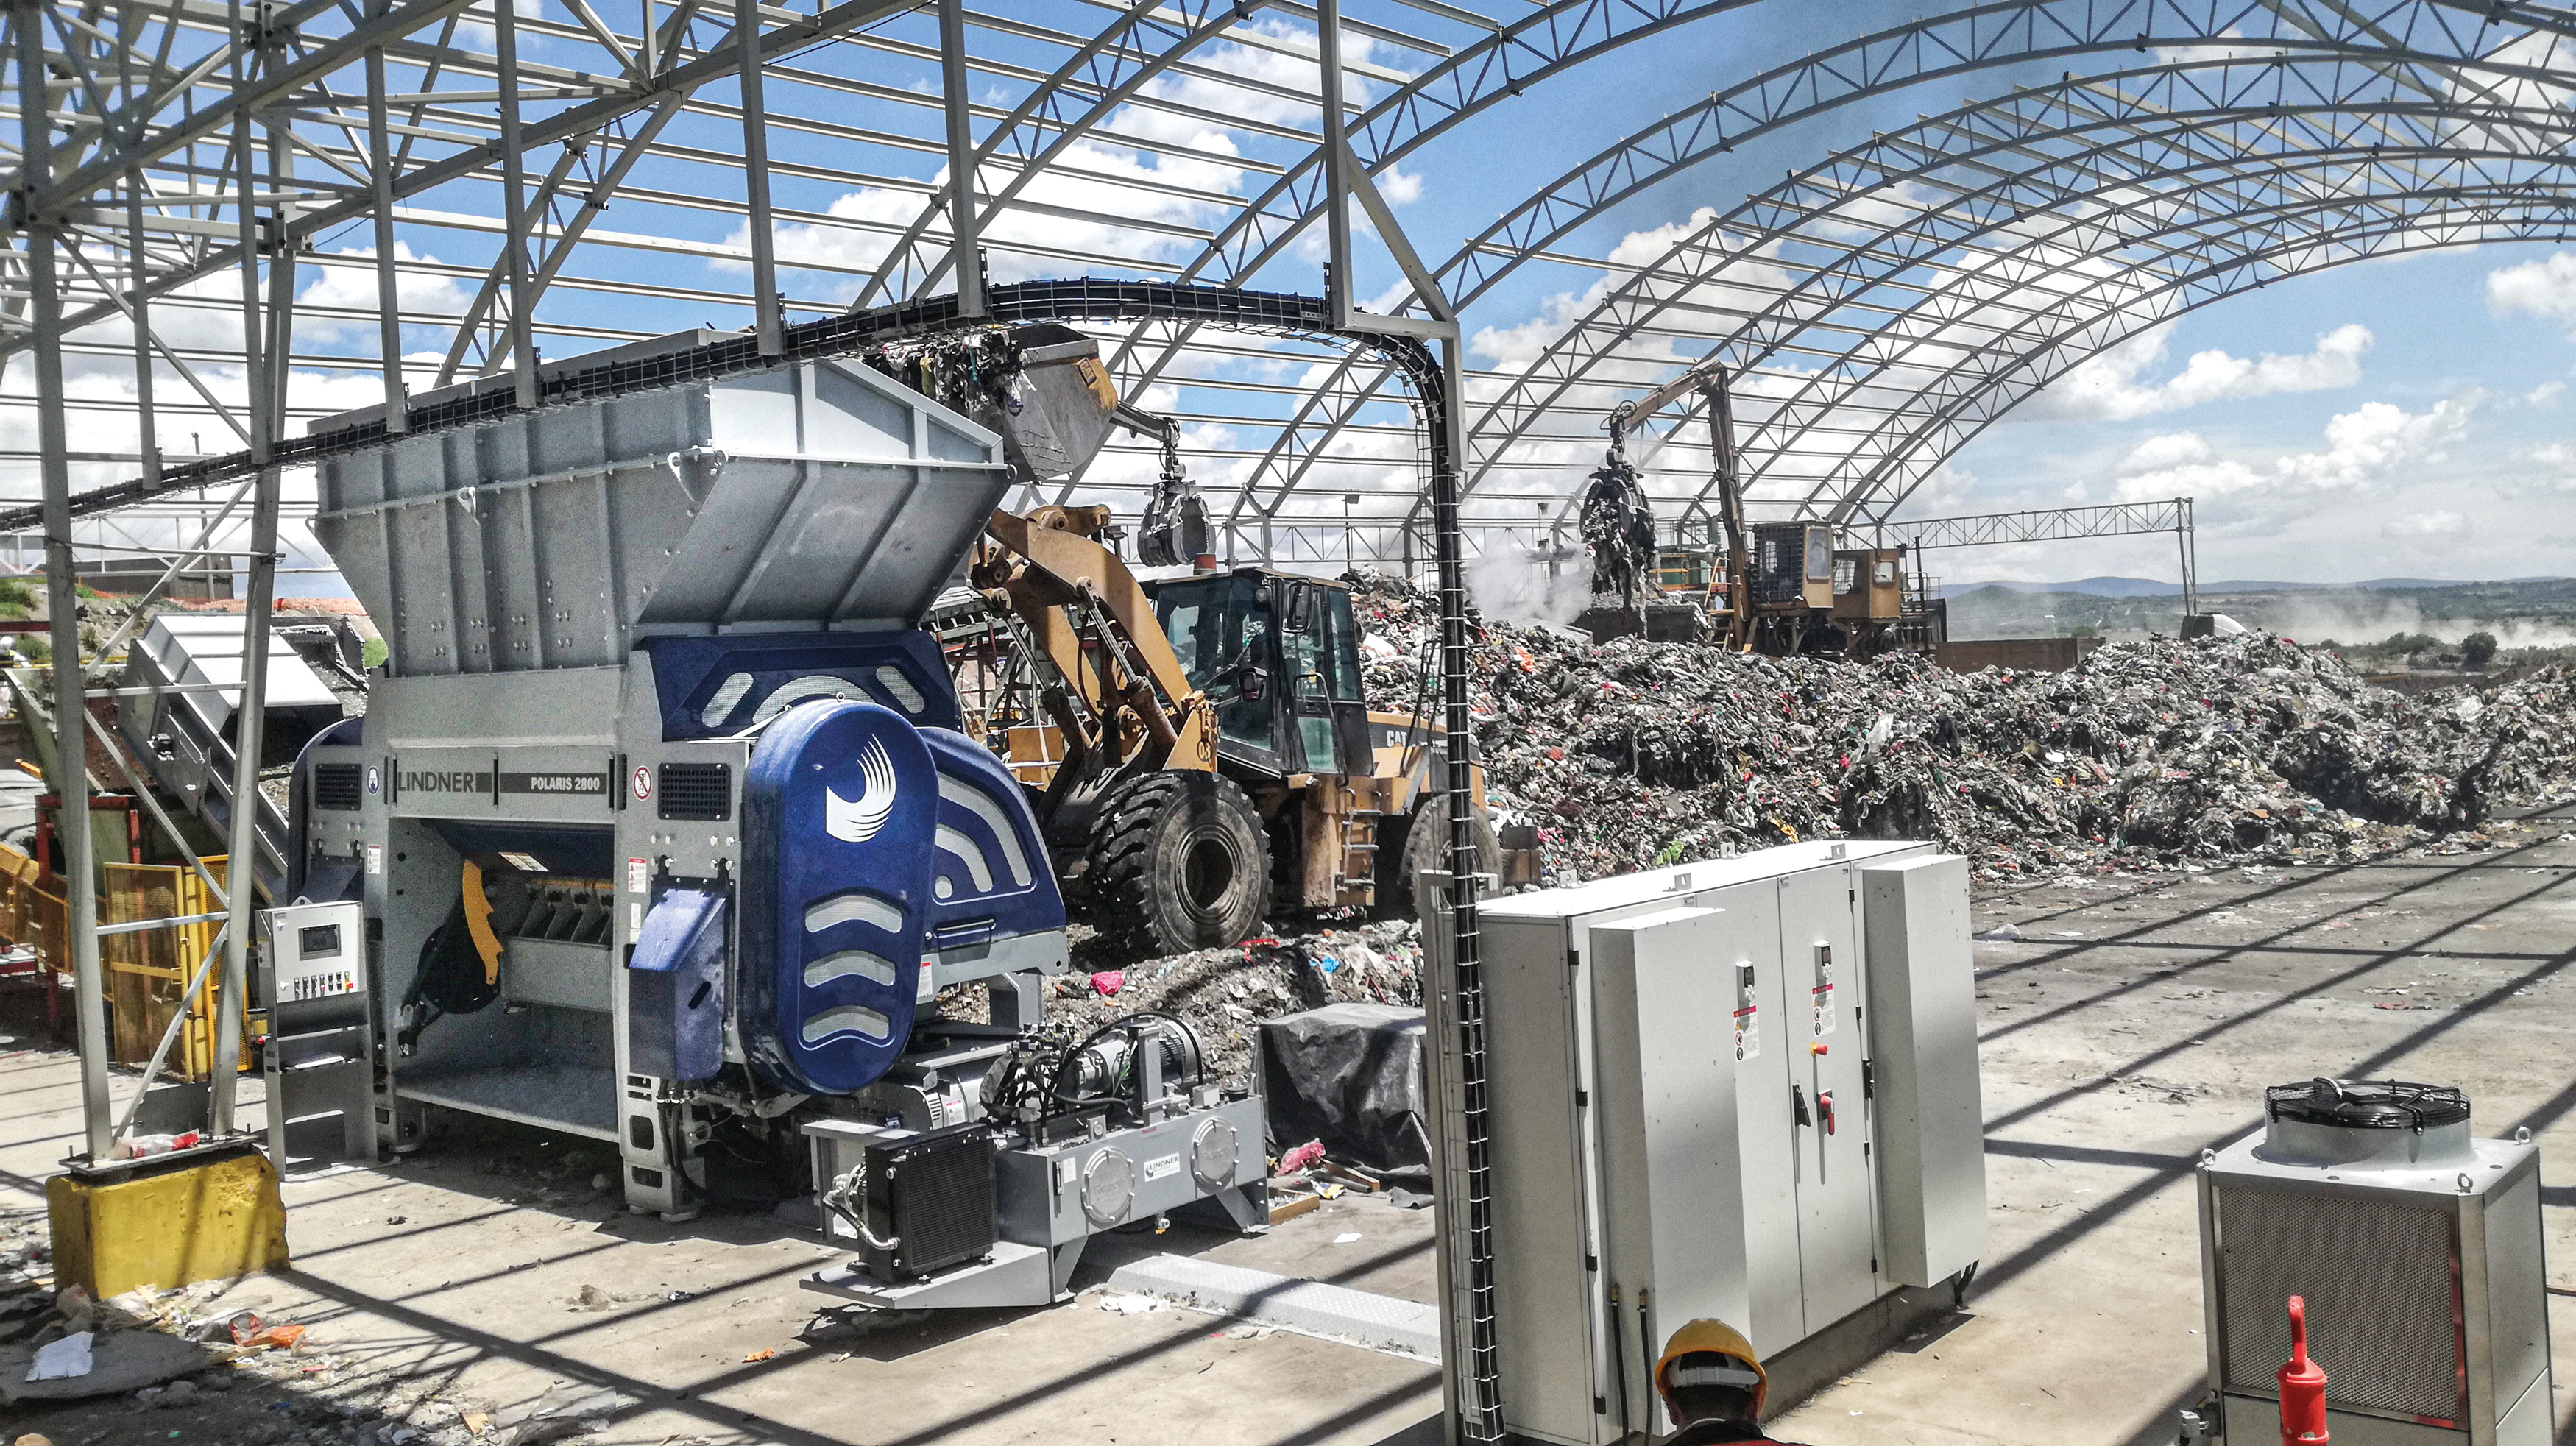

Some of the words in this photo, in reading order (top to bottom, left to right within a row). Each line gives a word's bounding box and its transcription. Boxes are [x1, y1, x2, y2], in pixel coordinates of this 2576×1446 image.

[1080, 361, 1095, 383] CAT
[1387, 730, 1407, 747] CAT
[398, 772, 474, 793] LINDNER
[531, 777, 572, 790] POLARIS
[575, 777, 600, 791] 2800
[1150, 1156, 1178, 1170] LINDNER
